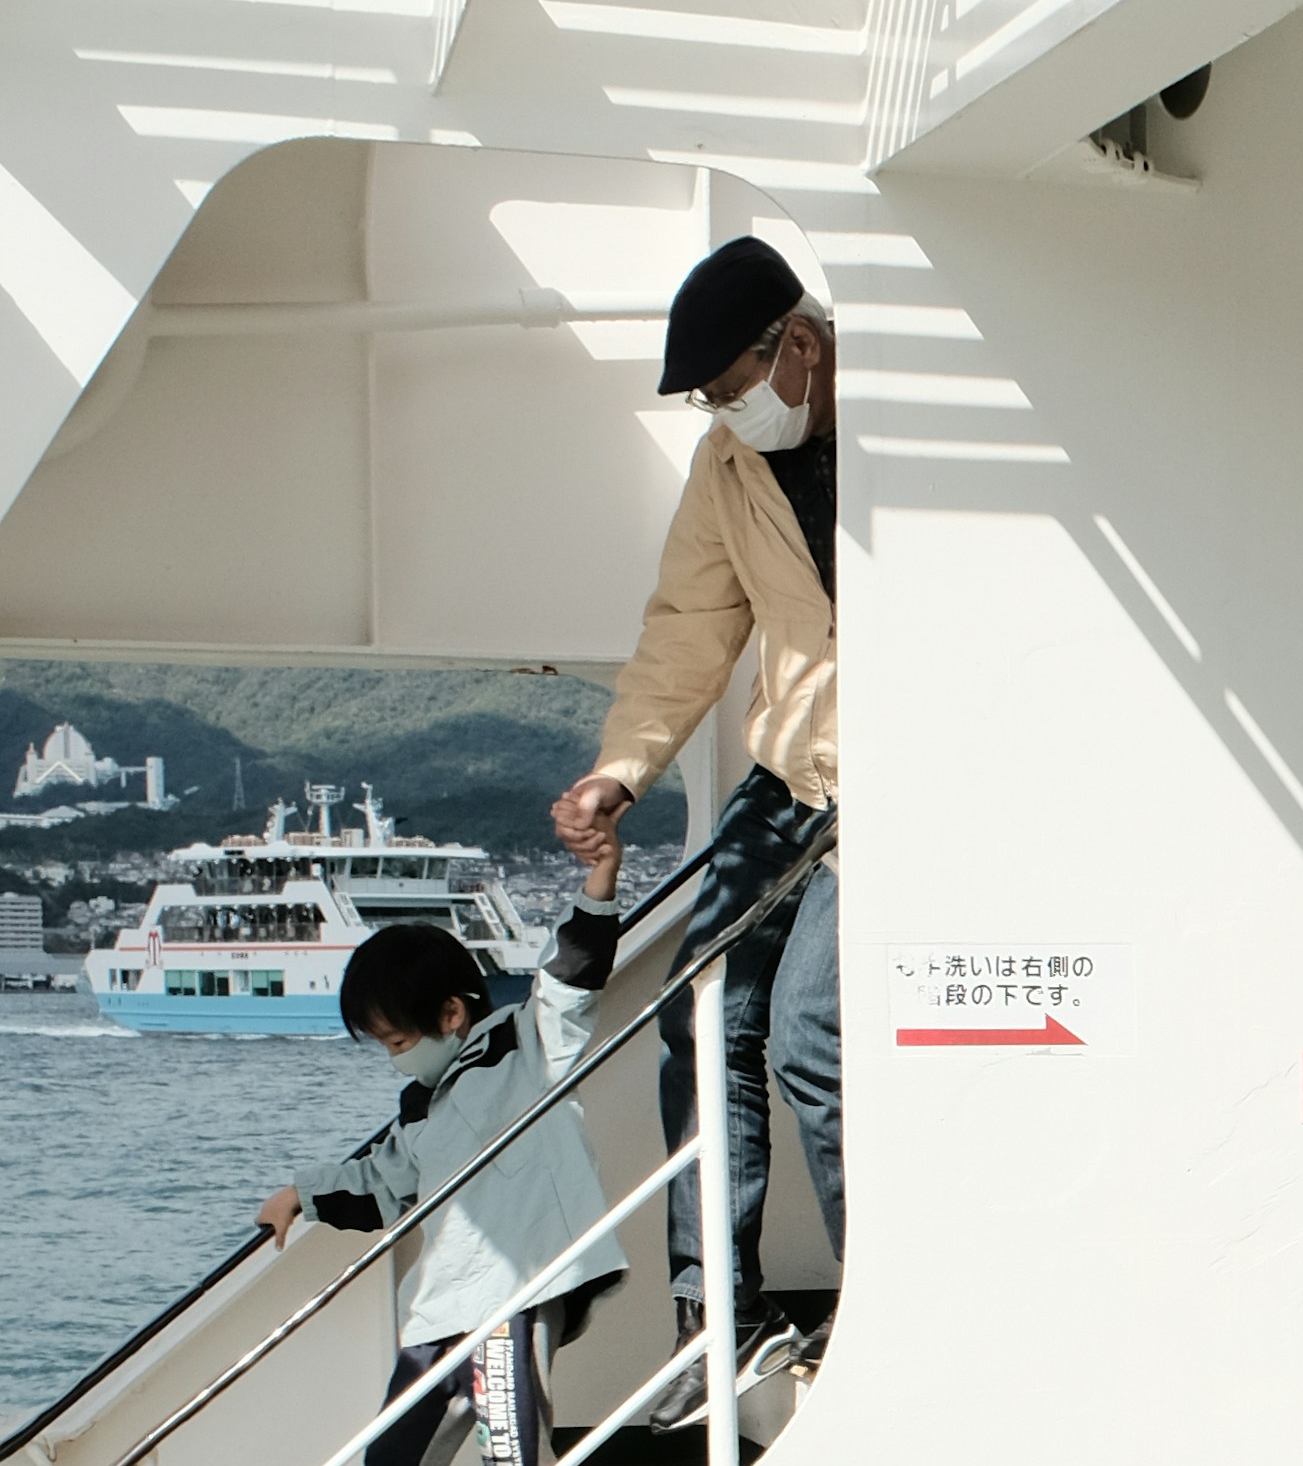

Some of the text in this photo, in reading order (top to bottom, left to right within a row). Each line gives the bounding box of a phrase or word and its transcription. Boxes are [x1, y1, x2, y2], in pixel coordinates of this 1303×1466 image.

[486, 1338, 509, 1431] WELCOME
[505, 1339, 515, 1390] STANDARD
[491, 1432, 513, 1458] TO
